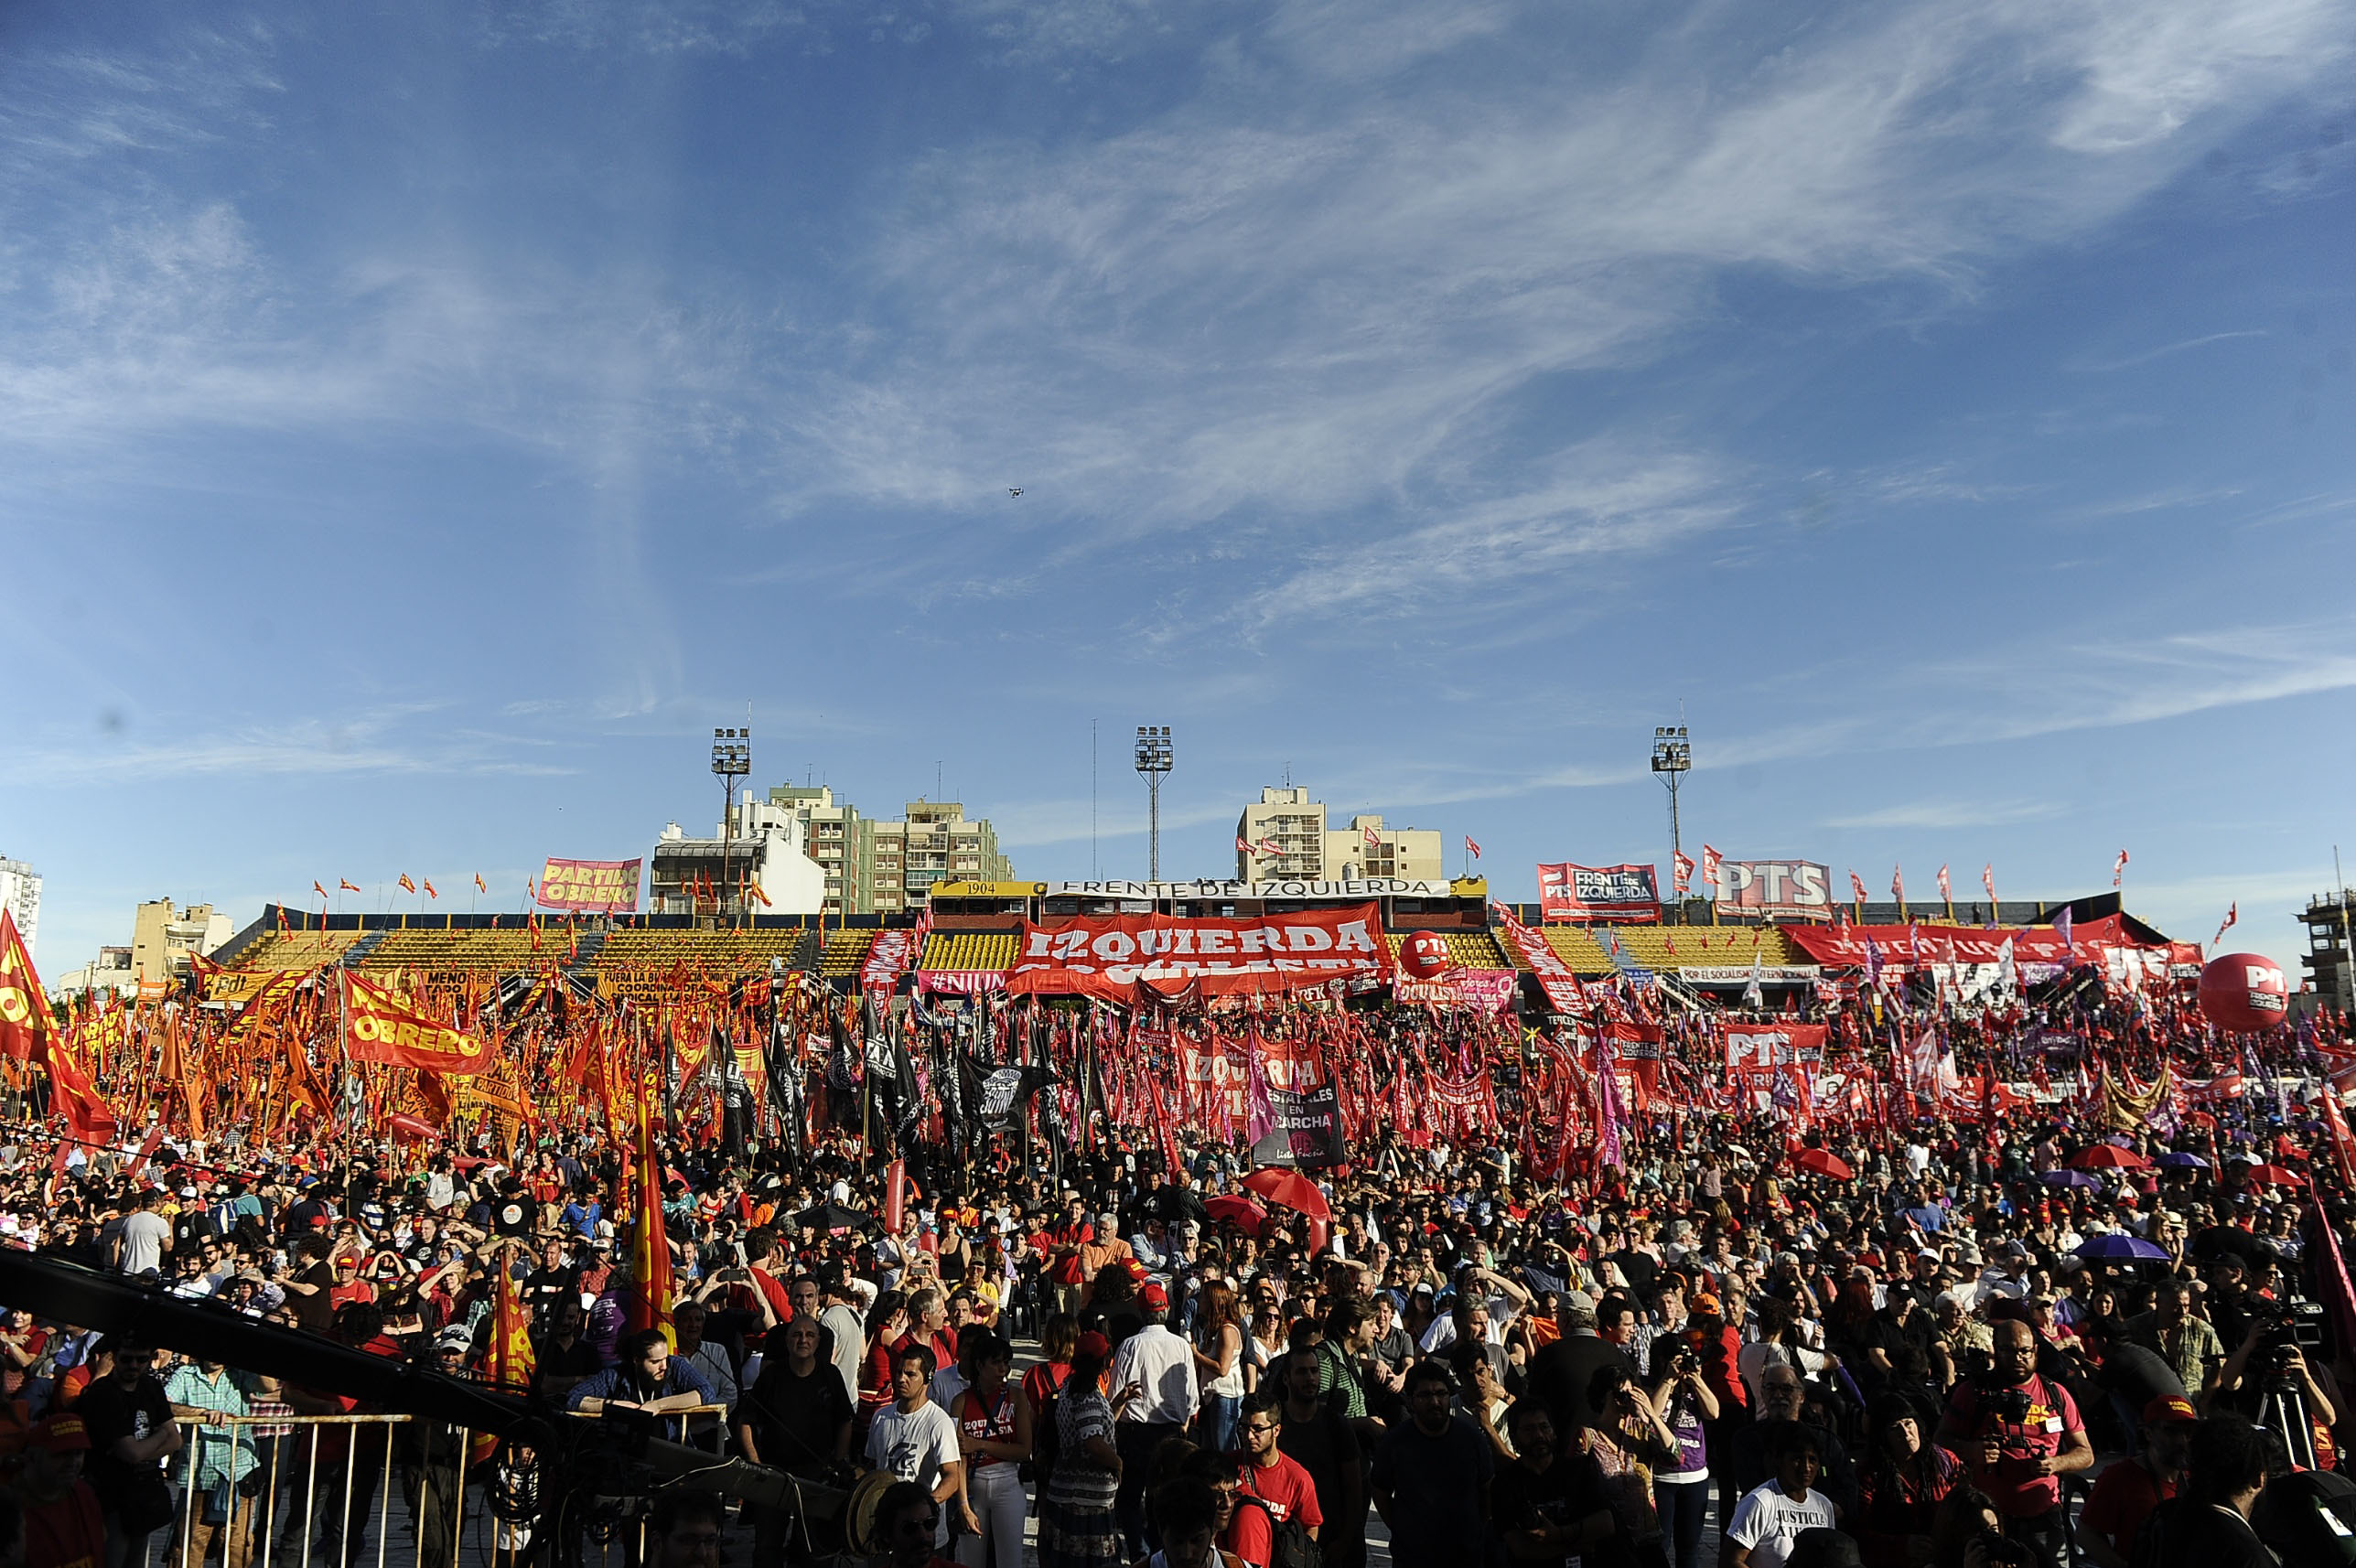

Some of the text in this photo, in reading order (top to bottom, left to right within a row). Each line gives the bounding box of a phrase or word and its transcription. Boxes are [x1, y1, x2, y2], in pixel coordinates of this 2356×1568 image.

[543, 865, 640, 885] PARTIDO
[1576, 872, 1627, 886] FRENTE
[968, 884, 995, 895] 1904
[1064, 881, 1188, 897] FRENTE
[1200, 883, 1240, 897] DE
[1252, 880, 1431, 897] IZQUIERDA
[1544, 885, 1571, 898] PTS
[1576, 885, 1651, 898] IZQUIERDA
[1717, 864, 1827, 905] PTS
[546, 883, 638, 903] OBRERO
[1027, 920, 1377, 961] IZQUIERDA
[1415, 938, 1447, 954] PTS
[604, 972, 633, 983] FUERA
[633, 972, 646, 983] LA
[1702, 970, 1709, 979] EL
[2245, 965, 2285, 993] PT
[215, 975, 247, 995] pdt
[617, 983, 707, 993] COORDINAORA
[354, 1015, 482, 1057] OBRERO
[1727, 1032, 1790, 1067] PTS
[477, 1077, 515, 1100] PARTIDO
[1289, 1105, 1304, 1114] EN
[1272, 1115, 1331, 1129] MARCHA
[1276, 1147, 1325, 1159] Lista Fucsia
[1776, 1509, 1826, 1526] JUSTICIA
[1779, 1526, 1786, 1537] X
